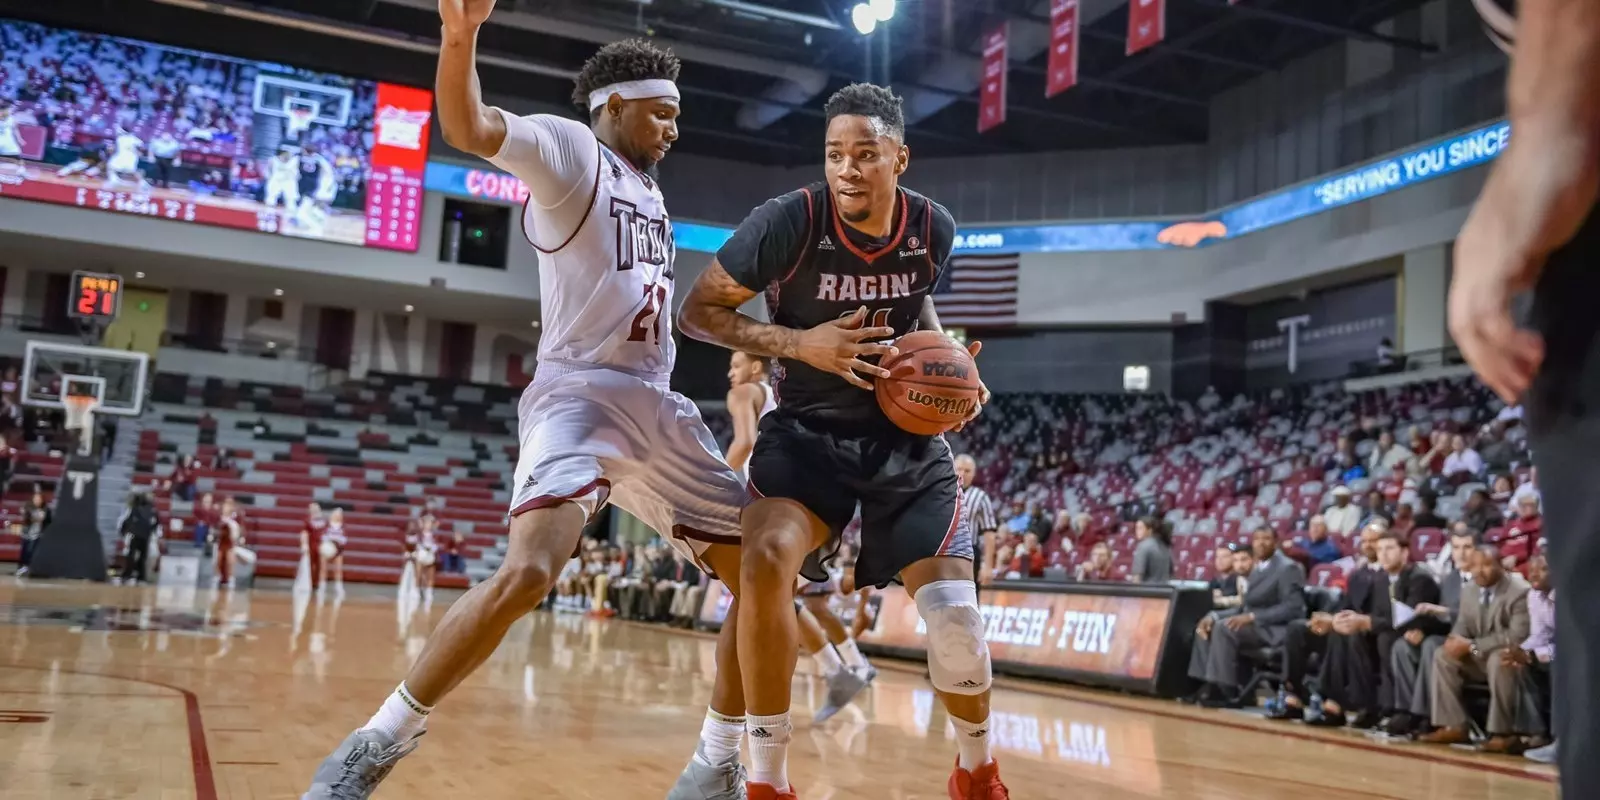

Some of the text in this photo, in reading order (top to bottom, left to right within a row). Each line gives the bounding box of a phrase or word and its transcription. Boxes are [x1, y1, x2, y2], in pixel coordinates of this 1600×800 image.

[1402, 147, 1445, 180] YOU
[1448, 125, 1510, 166] SINCE
[78, 288, 112, 314] 21
[922, 361, 969, 381] NCAA
[907, 387, 972, 415] Wilson
[67, 471, 94, 500] T
[1056, 611, 1117, 653] FUN
